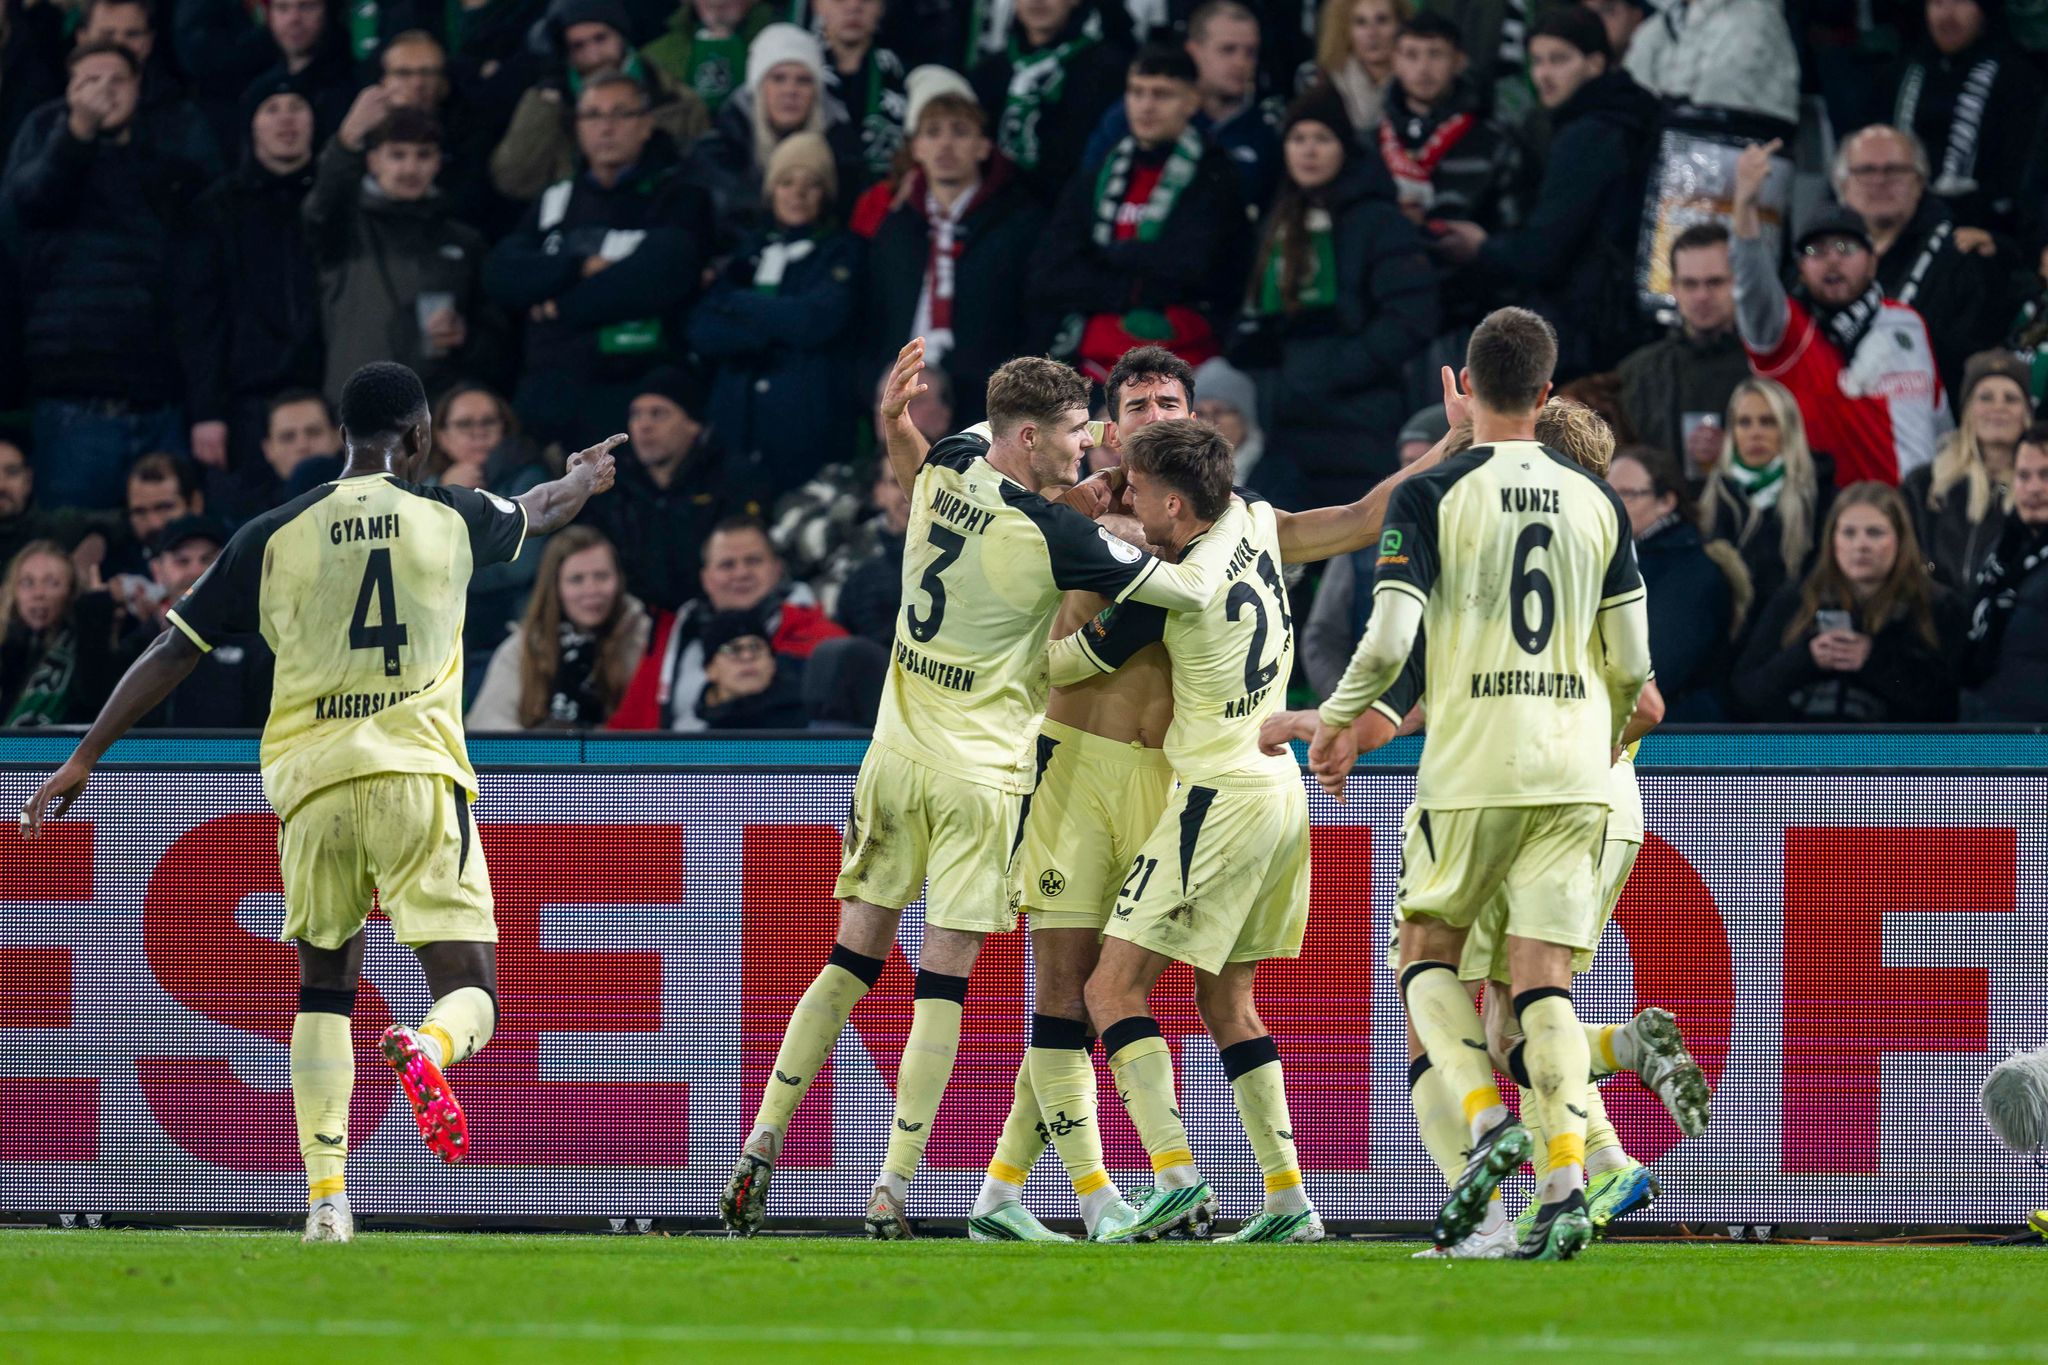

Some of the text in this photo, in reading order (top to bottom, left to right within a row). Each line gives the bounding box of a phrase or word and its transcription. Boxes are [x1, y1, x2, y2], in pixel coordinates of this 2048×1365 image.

[930, 487, 997, 535] MURPHY
[1501, 488, 1560, 514] KUNZE
[330, 514, 400, 545] GYAMFI
[908, 521, 967, 642] 3
[1510, 522, 1555, 655] 6
[349, 547, 408, 677] 4
[1226, 549, 1292, 694] 21
[1471, 671, 1586, 699] KAISERSLAUTERN
[1119, 854, 1159, 902] 21
